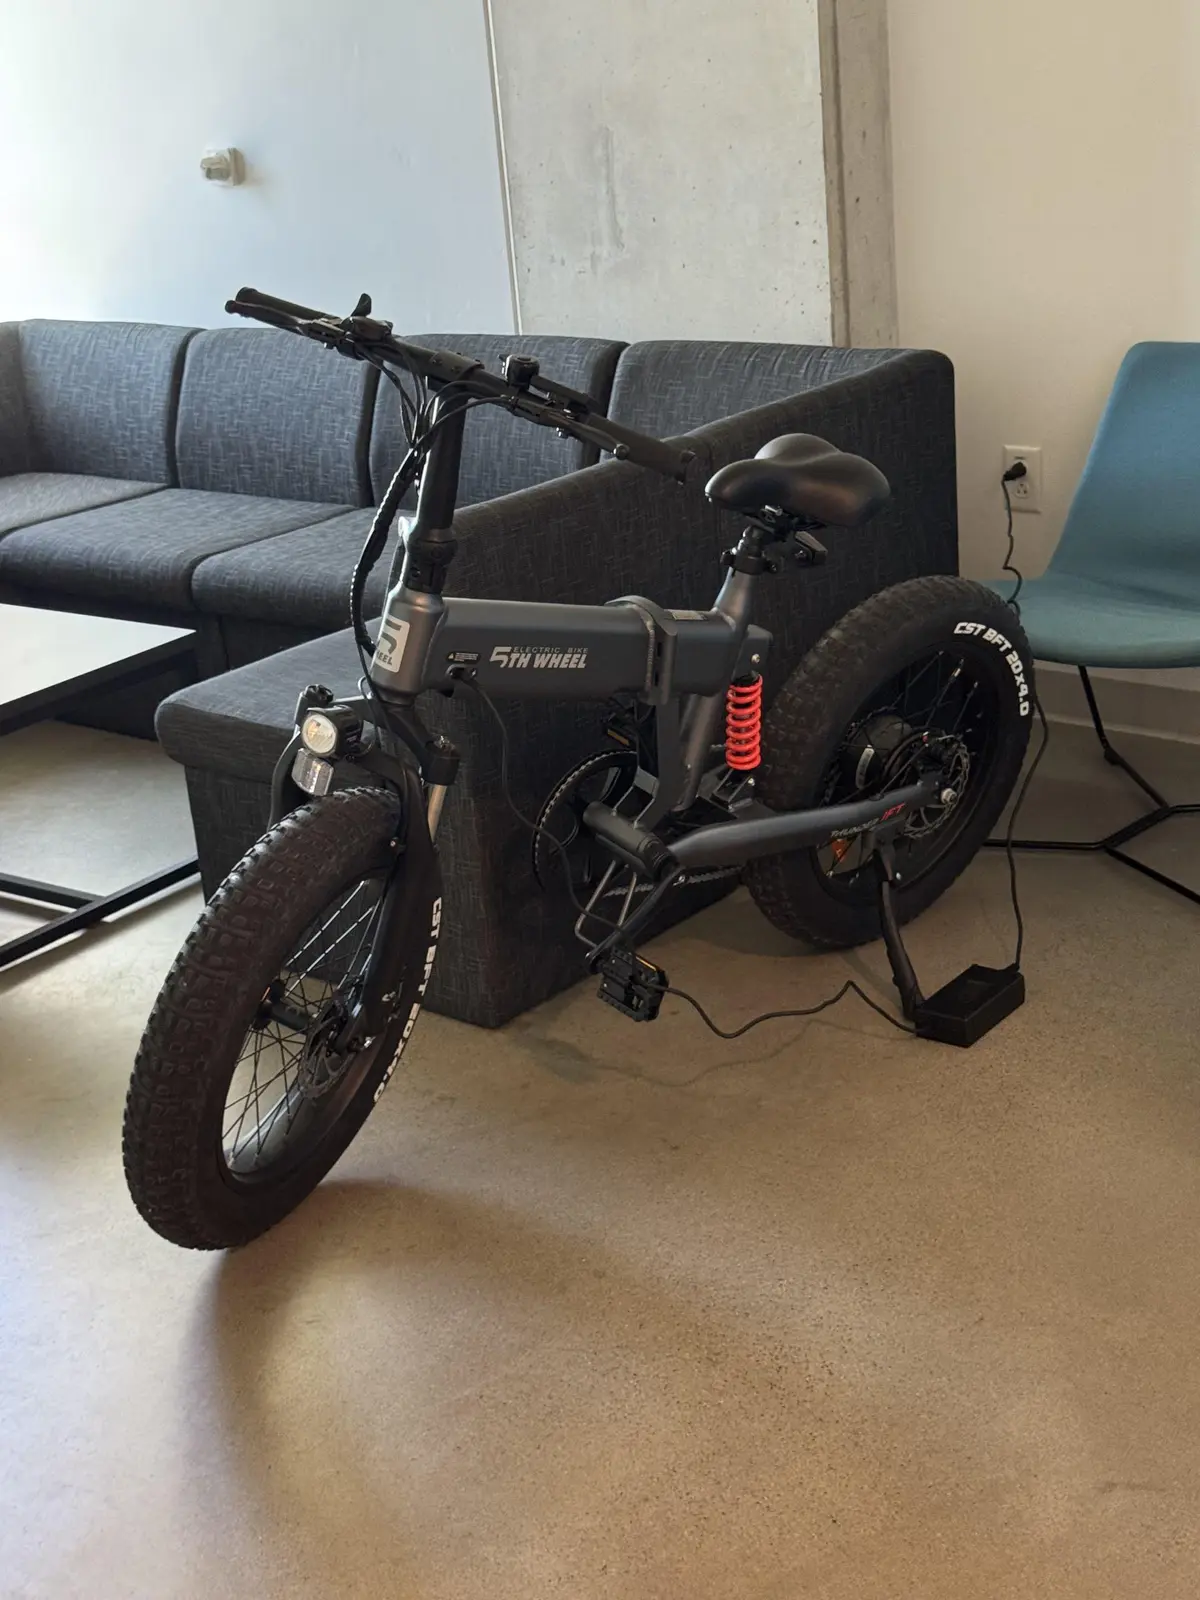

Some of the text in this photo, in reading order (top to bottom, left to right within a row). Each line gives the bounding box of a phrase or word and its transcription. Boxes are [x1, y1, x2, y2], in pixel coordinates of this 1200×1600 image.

[953, 621, 986, 636] CST
[982, 627, 1012, 652] BFT
[489, 646, 530, 669] 5TH
[533, 653, 587, 669] WHEEL
[430, 897, 442, 939] CST
[418, 944, 437, 996] BFT
